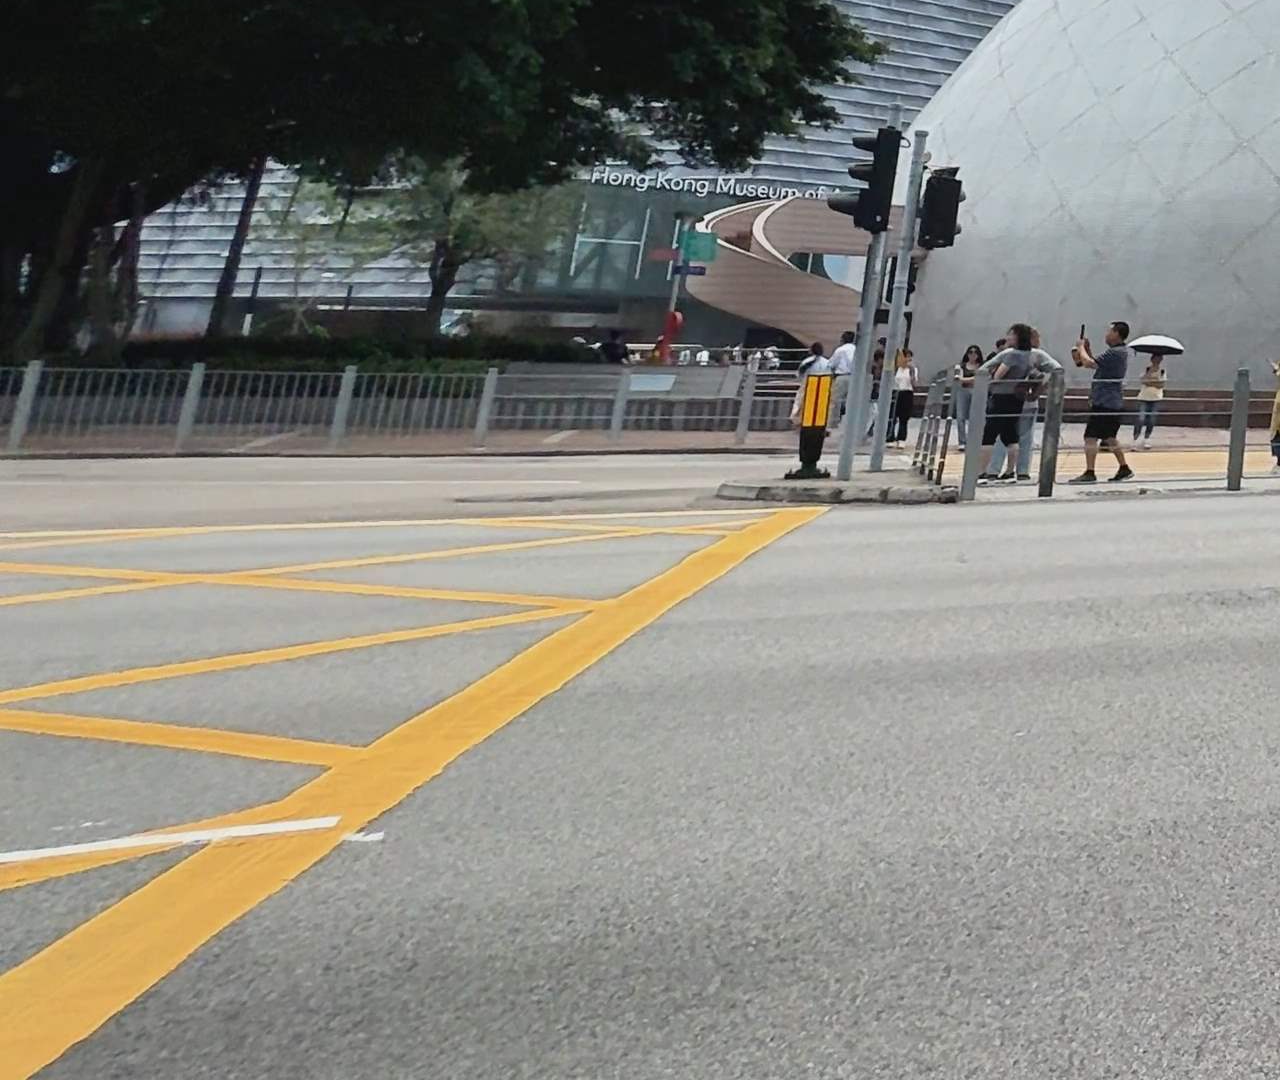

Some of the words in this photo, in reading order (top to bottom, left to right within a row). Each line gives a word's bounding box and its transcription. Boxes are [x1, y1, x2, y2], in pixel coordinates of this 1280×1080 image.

[591, 166, 650, 191] Hong
[656, 171, 709, 197] Kong
[715, 176, 799, 199] Museum
